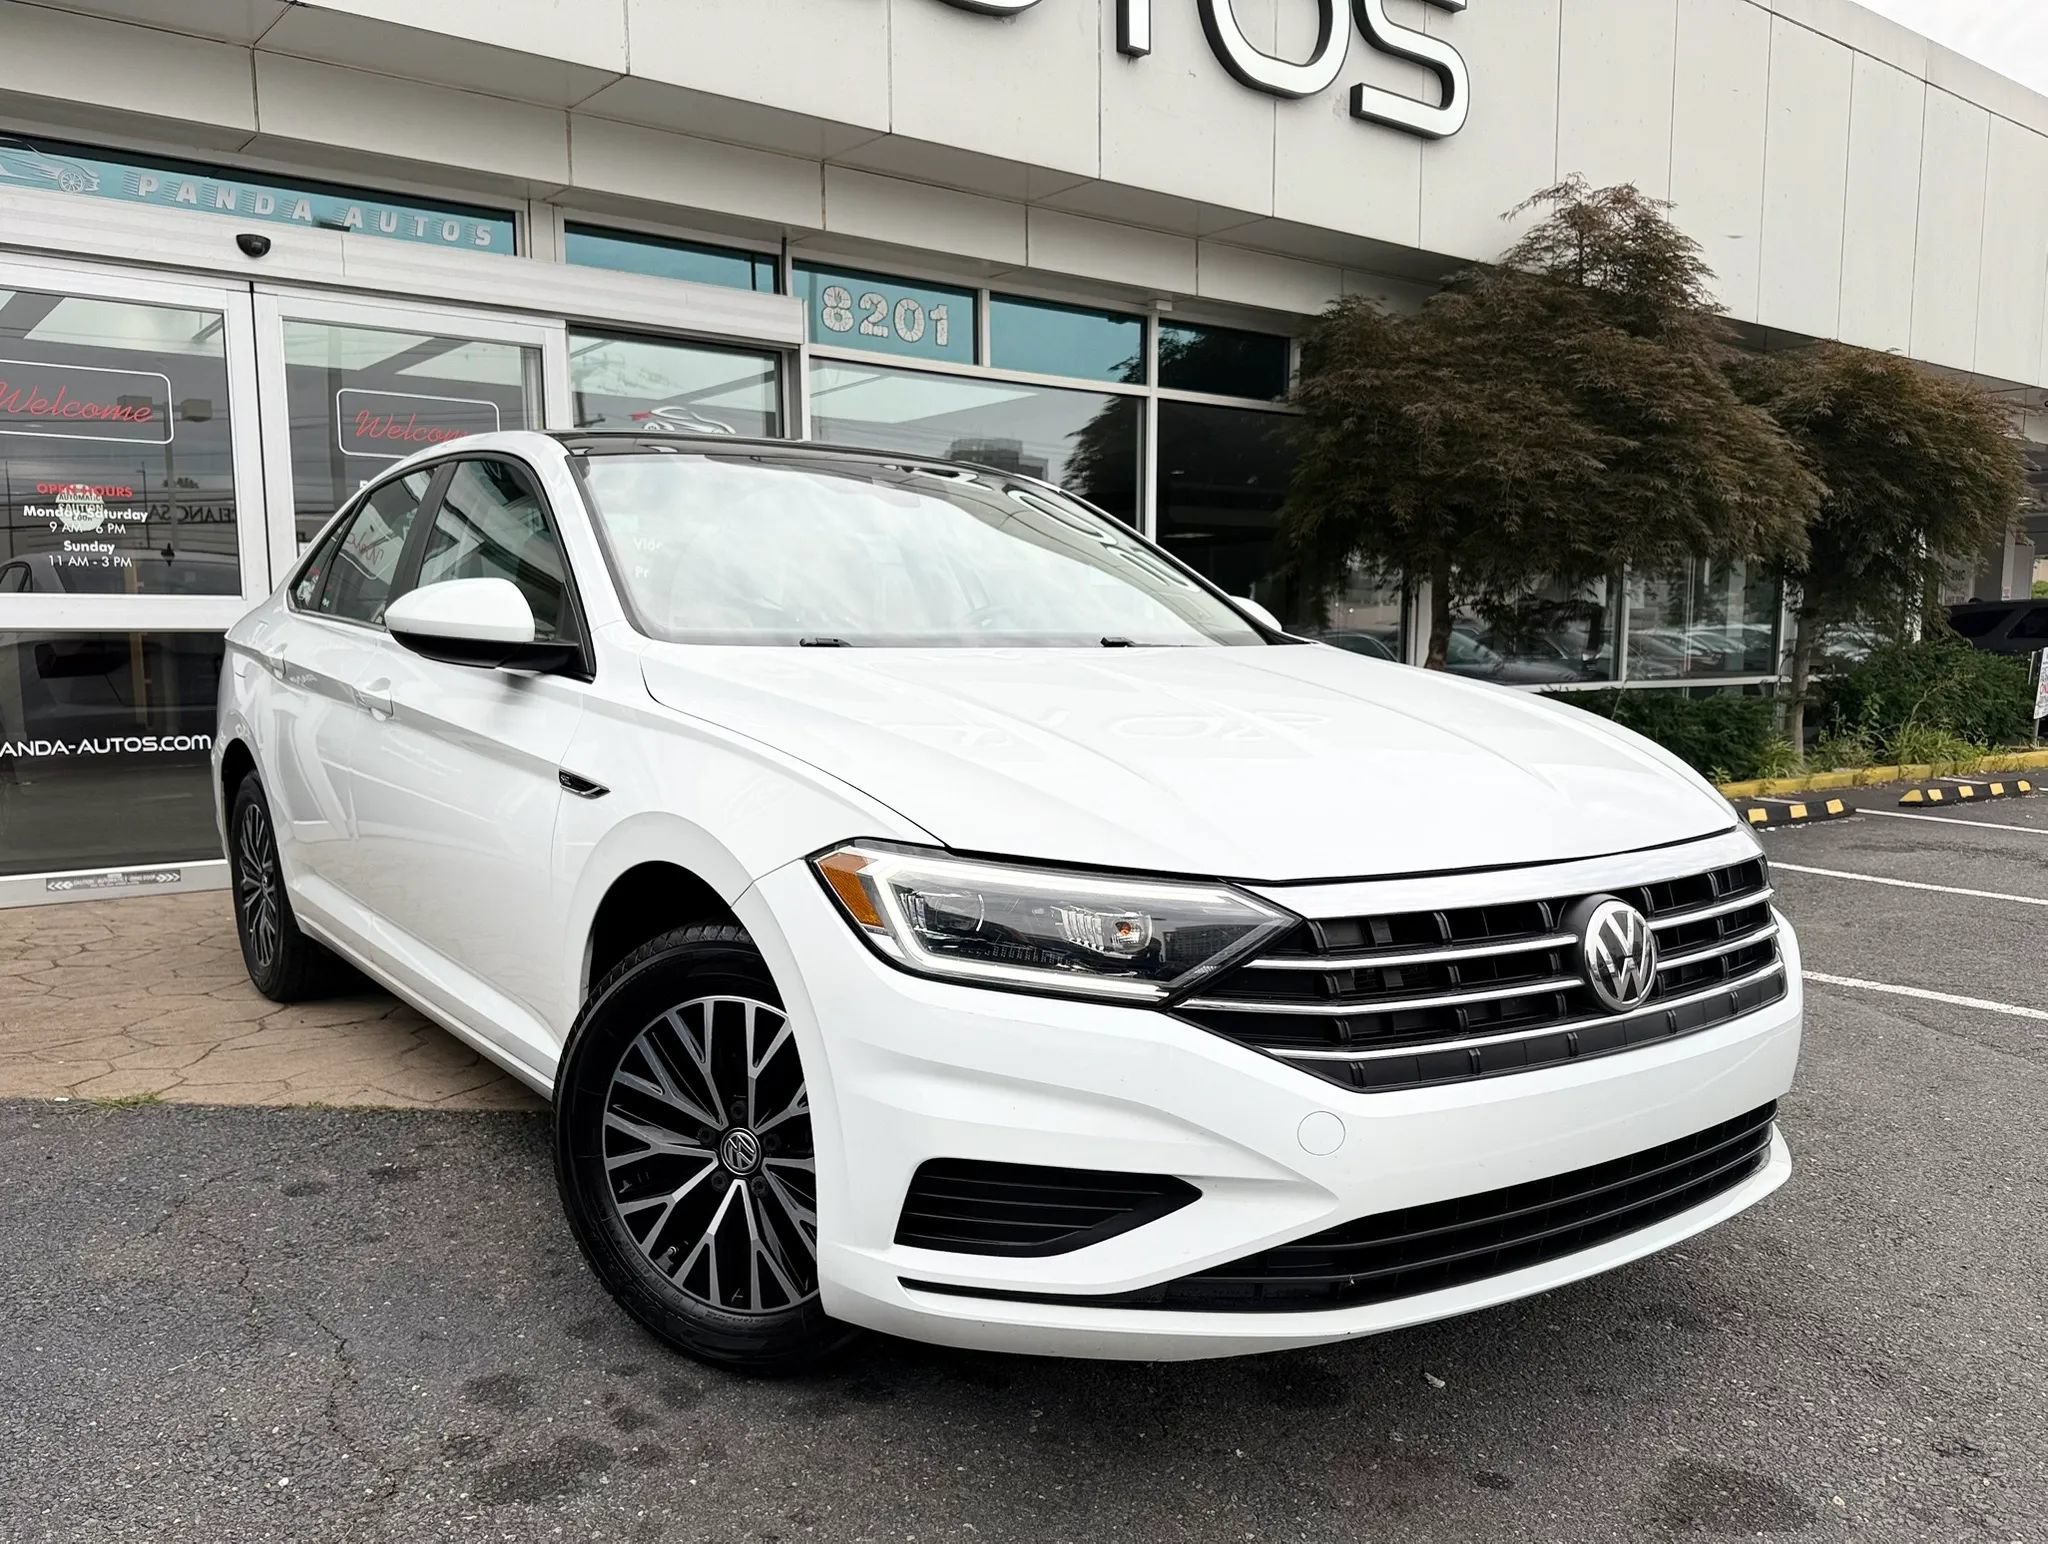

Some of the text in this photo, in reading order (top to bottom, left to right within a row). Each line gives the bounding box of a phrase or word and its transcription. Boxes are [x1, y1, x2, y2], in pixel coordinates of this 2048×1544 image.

[136, 173, 493, 247] PANDA AUTOS
[821, 285, 949, 347] 8201
[49, 521, 127, 535] 9 AM 6 PM
[63, 540, 116, 555] Sunday
[48, 555, 63, 567] 11
[68, 556, 90, 567] AM
[101, 556, 110, 568] 3
[113, 556, 133, 568] PM
